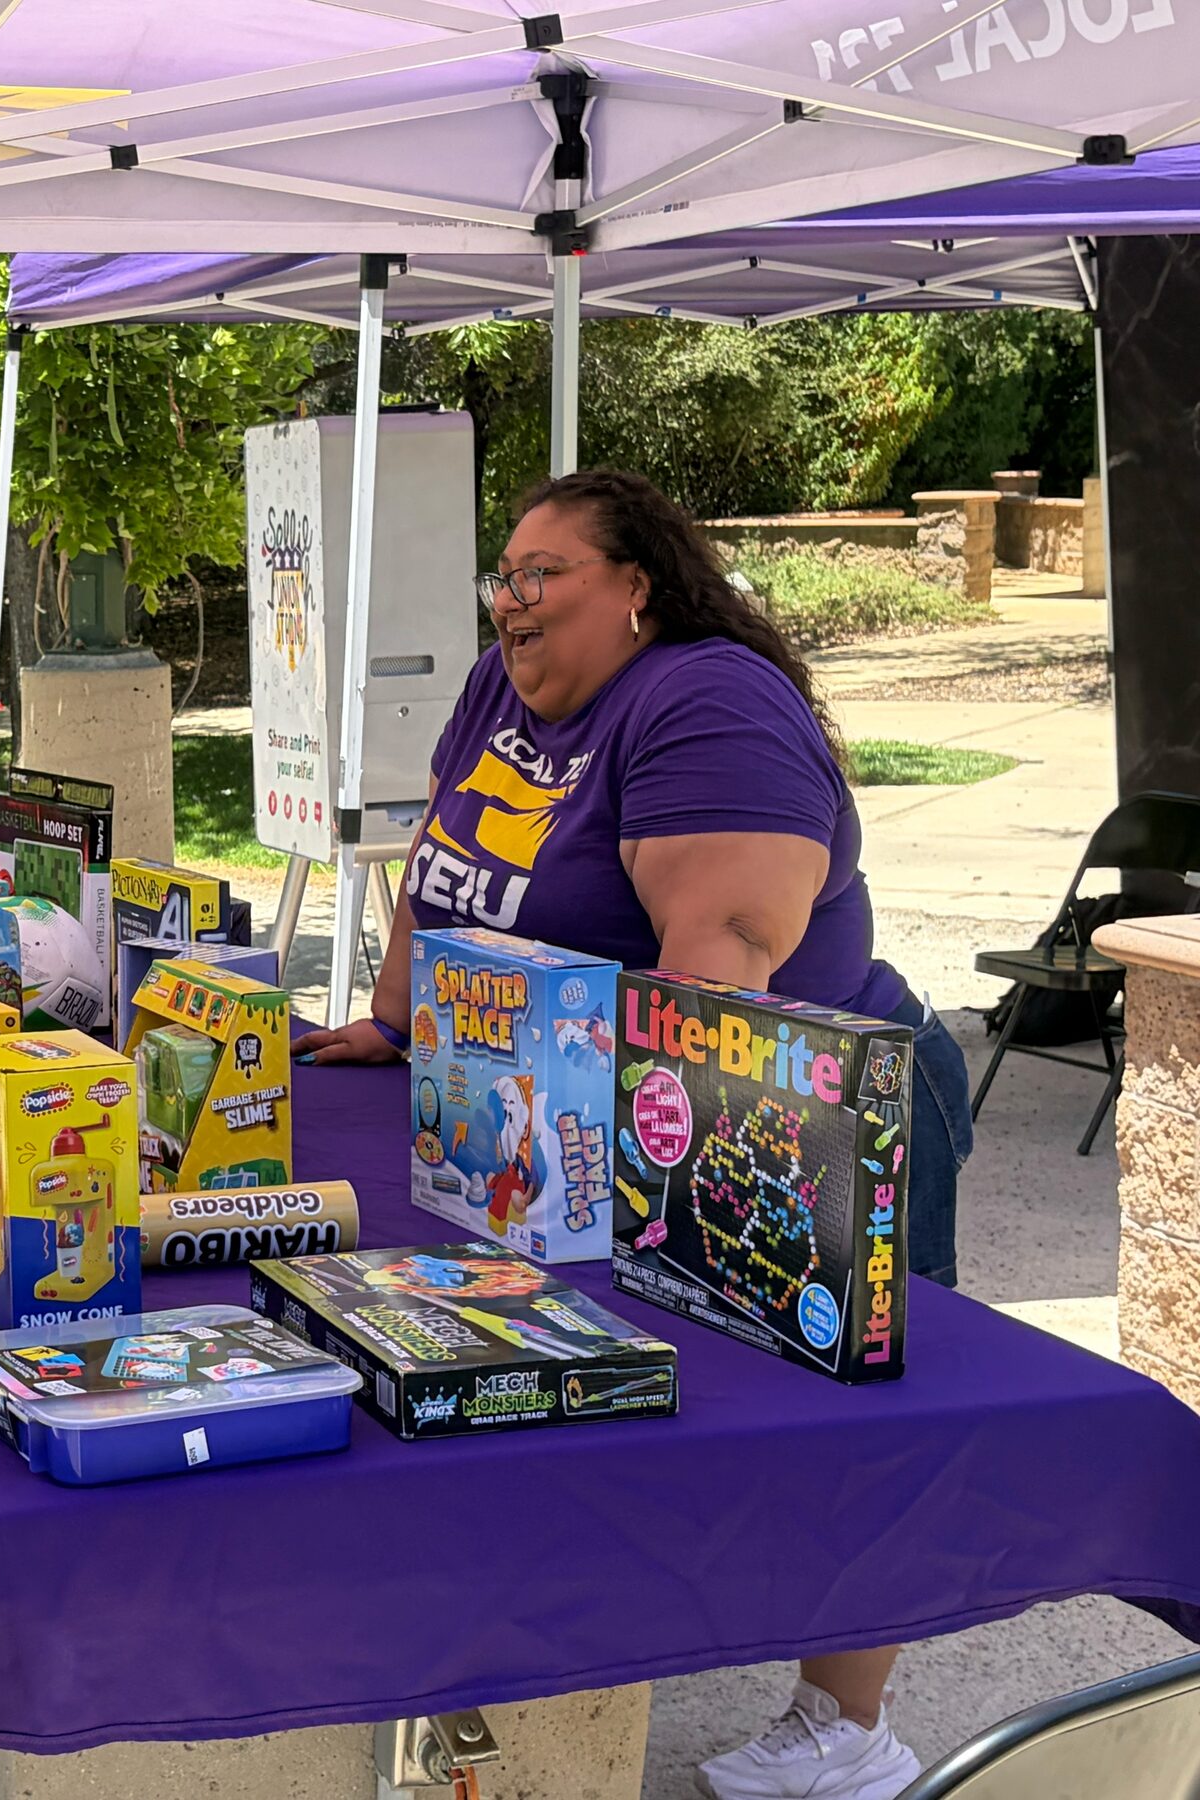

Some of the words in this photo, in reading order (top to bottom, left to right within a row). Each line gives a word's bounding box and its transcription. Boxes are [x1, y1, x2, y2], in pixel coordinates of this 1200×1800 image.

[268, 728, 288, 749] Share
[290, 733, 302, 752] and
[304, 734, 321, 756] Print
[488, 726, 556, 785] OCAL
[277, 761, 292, 780] your
[43, 819, 67, 838] HOOP
[67, 825, 83, 843] SET
[406, 842, 531, 930] SEIU
[434, 959, 527, 1010] SPLATTER
[453, 1002, 514, 1052] FACE
[25, 1089, 71, 1111] Popsicle
[211, 1092, 253, 1111] GARBAGE
[256, 1085, 286, 1102] TRUCK
[225, 1102, 274, 1129] SLIME
[558, 1114, 594, 1232] SPLATTER
[582, 1126, 611, 1204] FACE
[39, 1174, 68, 1190] Popsicle
[171, 1190, 322, 1219] Goldbears
[162, 1220, 340, 1266] HARIBO
[19, 1310, 72, 1328] SNOW
[77, 1304, 123, 1321] CONE
[476, 1371, 541, 1397] MECH
[462, 1390, 557, 1417] MONSTERS
[471, 1416, 494, 1425] DRAG
[495, 1413, 519, 1423] RACE
[520, 1411, 548, 1421] TRACK
